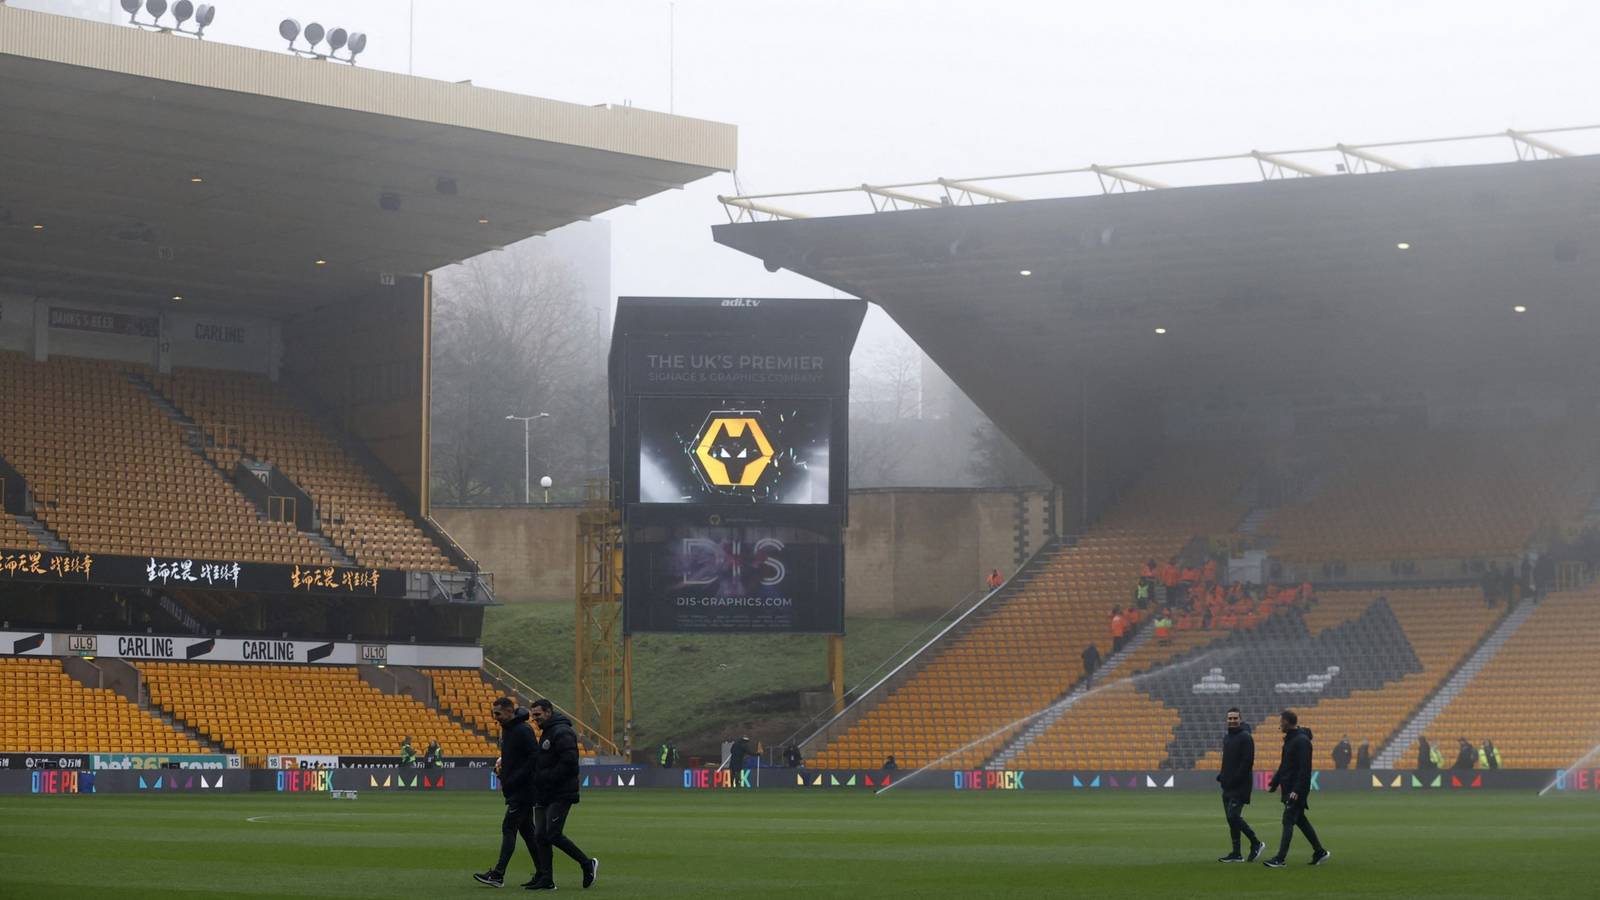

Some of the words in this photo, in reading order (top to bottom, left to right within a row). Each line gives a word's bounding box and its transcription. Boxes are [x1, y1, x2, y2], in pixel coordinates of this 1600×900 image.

[721, 298, 760, 307] adi.tv
[647, 354, 685, 369] THE
[690, 353, 734, 369] UK'S
[740, 355, 824, 370] PREMIER
[683, 538, 786, 586] DIS
[676, 597, 793, 607] DIS-GRAPHICS.COM
[74, 638, 93, 650] JL9
[118, 636, 174, 658] CARLING
[242, 640, 295, 662] CARLING
[364, 646, 385, 659] JL10
[230, 757, 240, 768] 15
[32, 771, 58, 793] ONE
[277, 770, 300, 791] ONE
[303, 770, 334, 791] PACK
[684, 769, 709, 788] ONE
[954, 771, 986, 789] ONE
[987, 770, 1024, 789] PACK
[1556, 769, 1589, 790] ONE
